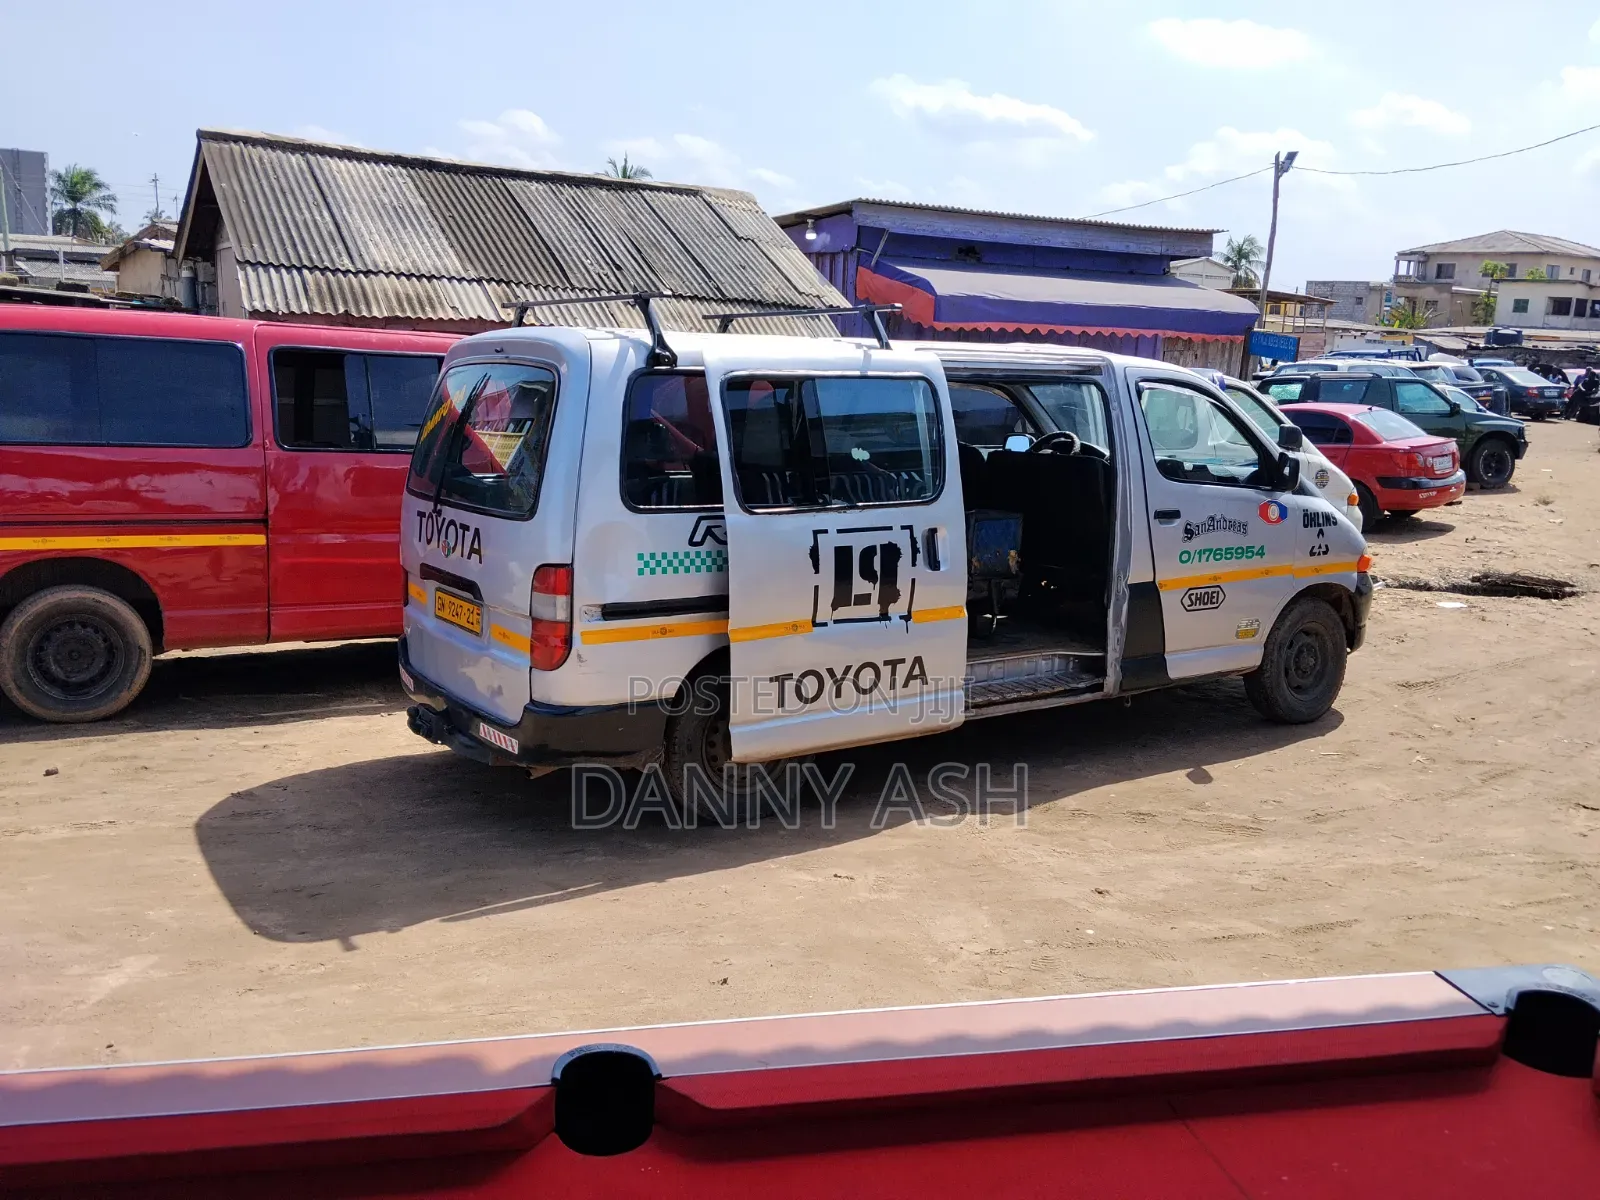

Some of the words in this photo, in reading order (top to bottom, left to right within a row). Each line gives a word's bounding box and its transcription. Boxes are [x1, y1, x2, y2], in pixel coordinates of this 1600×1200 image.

[416, 509, 482, 564] TOYOTA
[1186, 590, 1220, 608] SHOEI
[768, 655, 929, 709] TOYOTA
